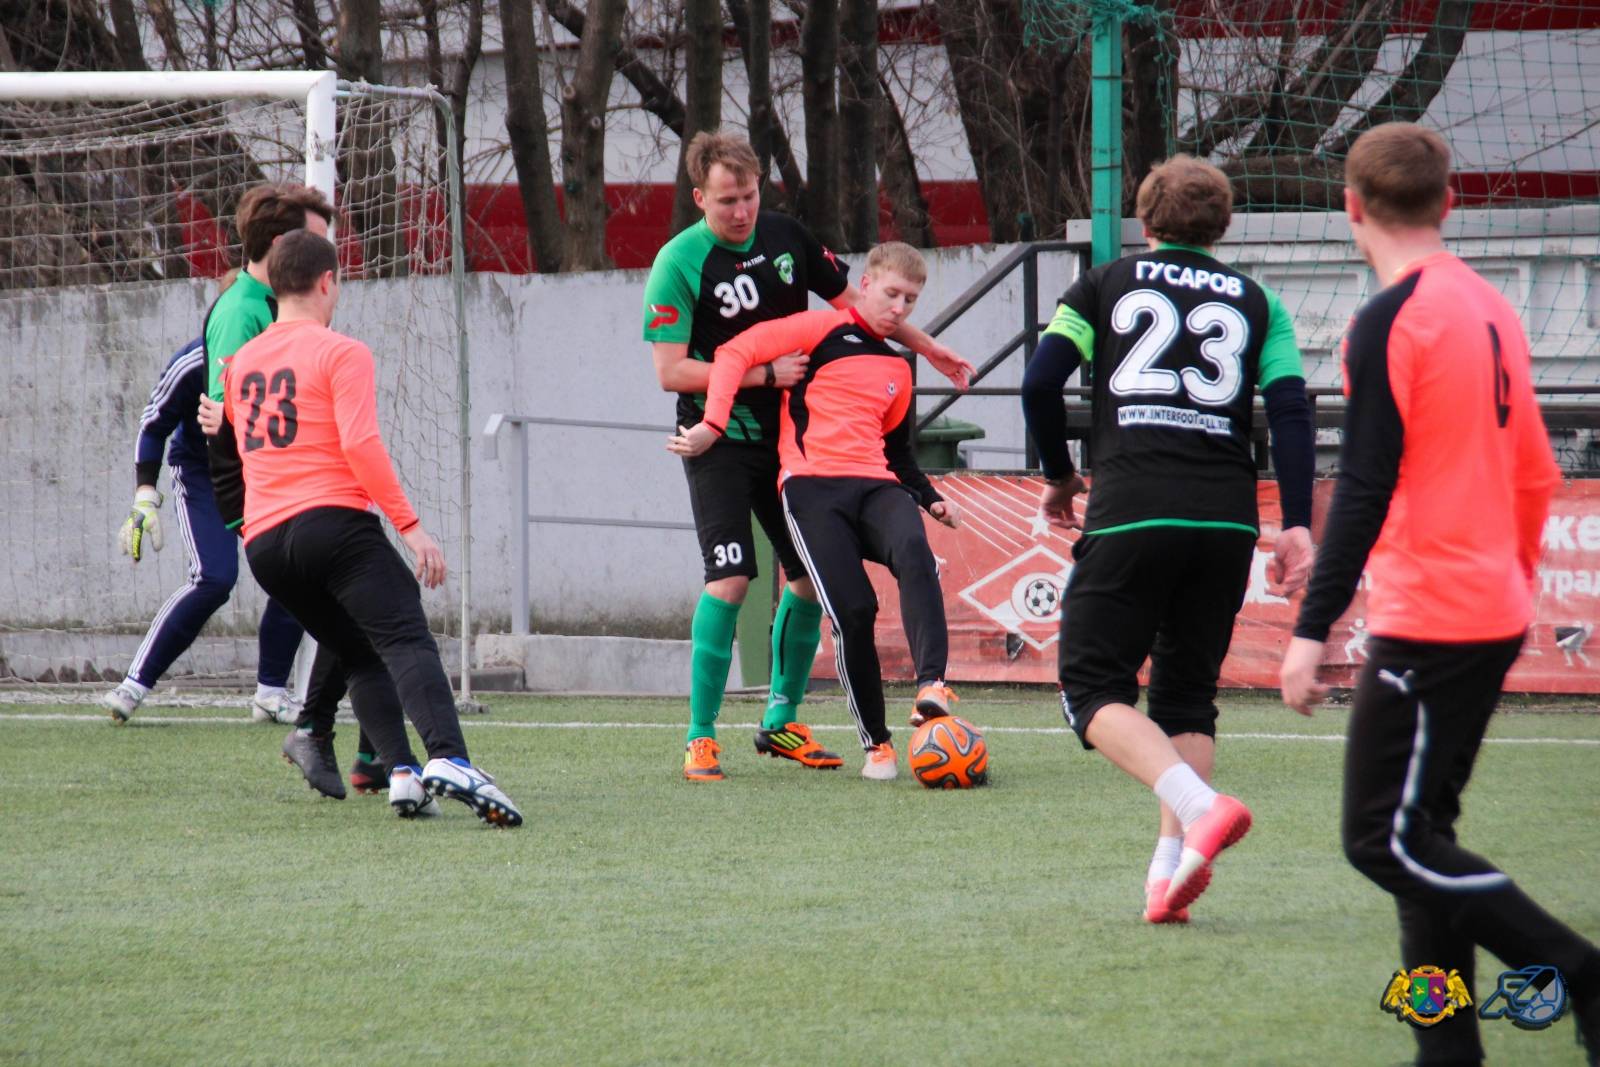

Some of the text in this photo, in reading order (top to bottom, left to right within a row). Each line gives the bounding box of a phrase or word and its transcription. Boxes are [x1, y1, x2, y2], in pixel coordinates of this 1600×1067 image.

[714, 274, 760, 319] 30
[1136, 261, 1243, 297] ГУСАРОВ
[1109, 289, 1249, 406] 23
[240, 368, 298, 453] 23
[714, 542, 742, 567] 30
